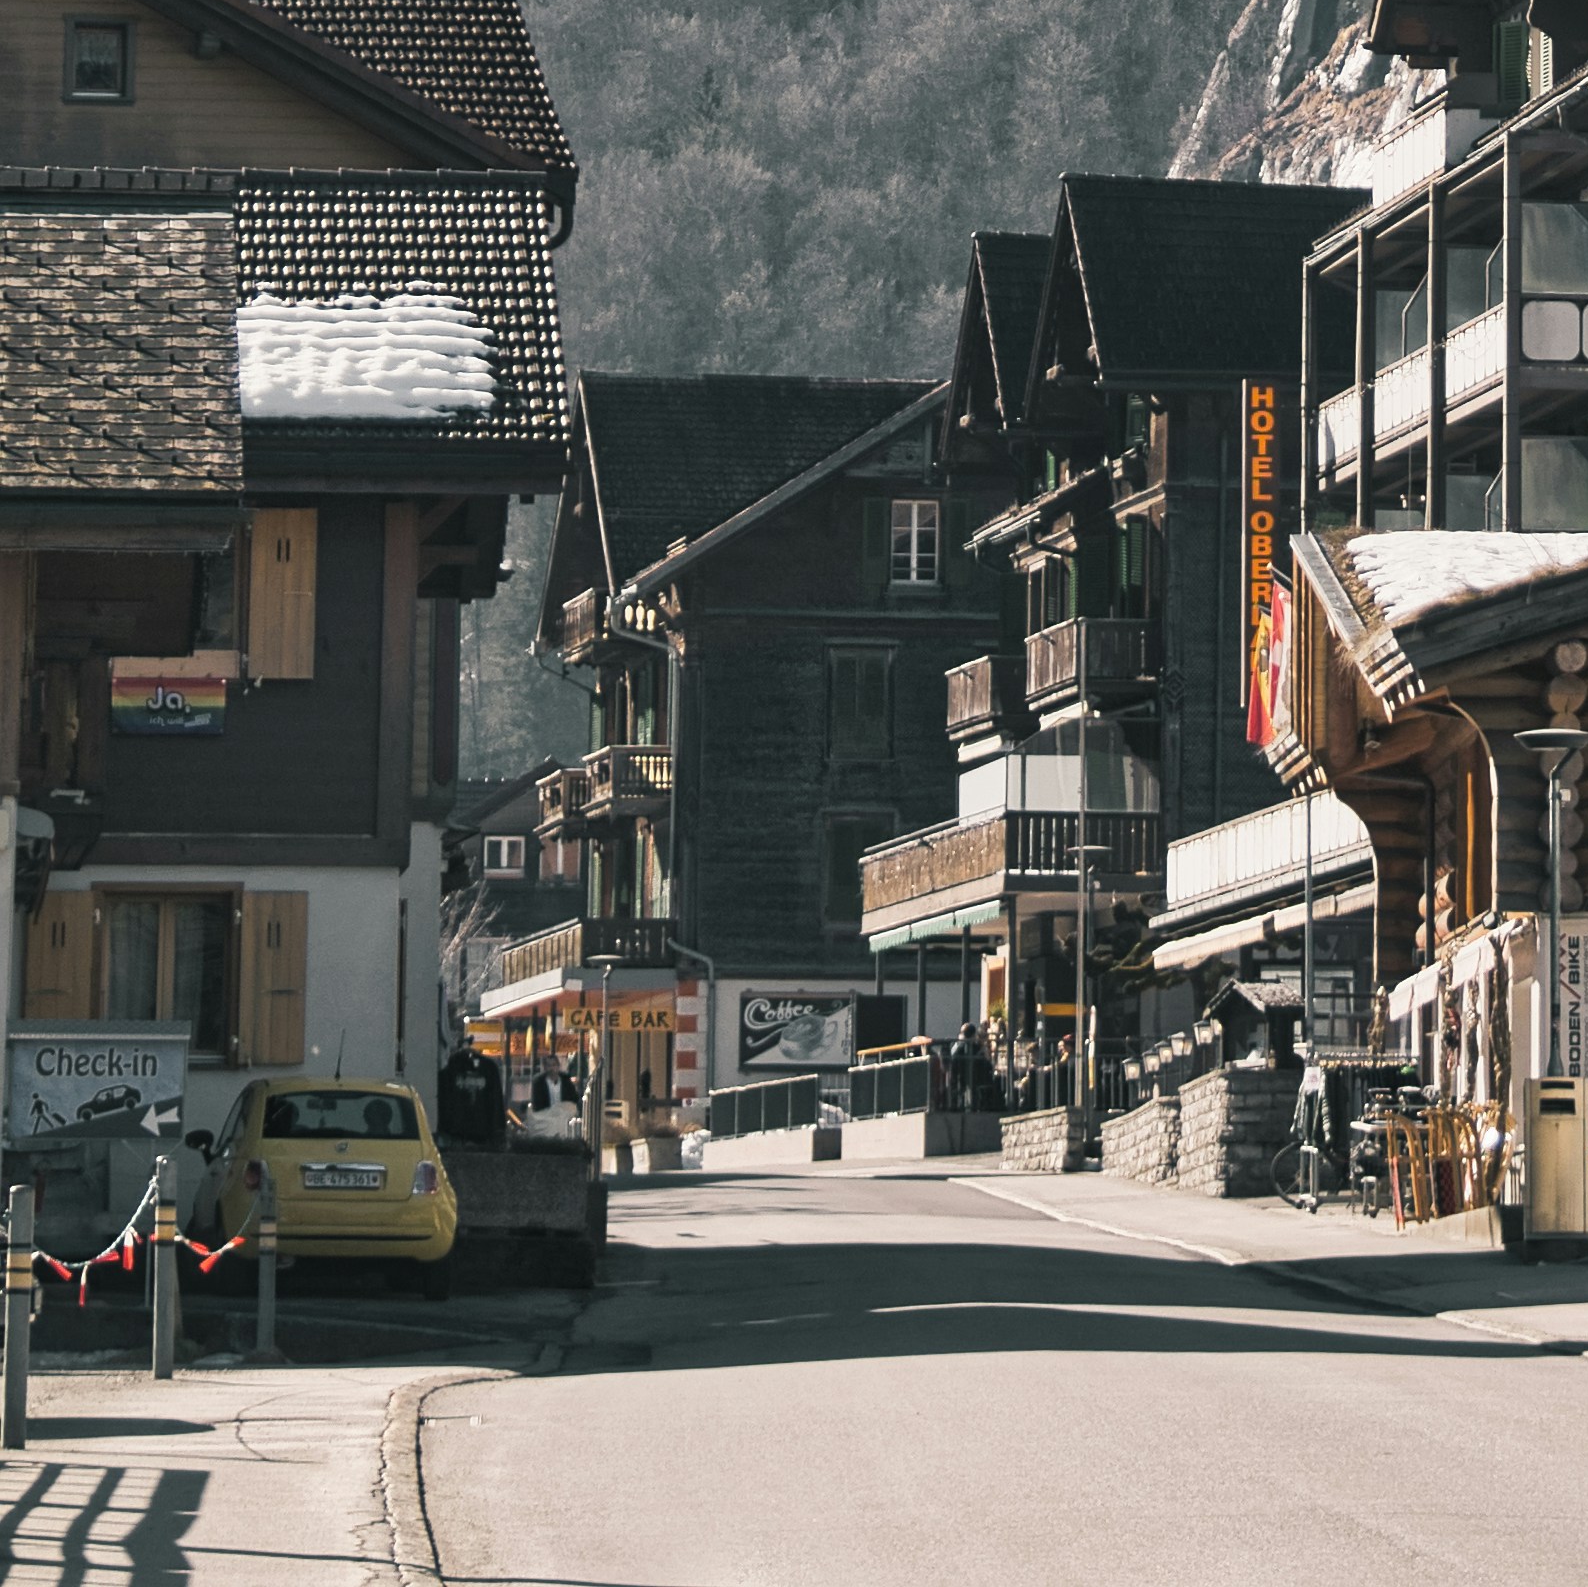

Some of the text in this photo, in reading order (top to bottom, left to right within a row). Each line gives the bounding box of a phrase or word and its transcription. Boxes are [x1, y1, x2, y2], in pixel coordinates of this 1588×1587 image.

[1251, 386, 1274, 501] HOTEL
[631, 1010, 669, 1028] BAR
[744, 998, 813, 1029] Coffee
[36, 1046, 157, 1077] Check-in
